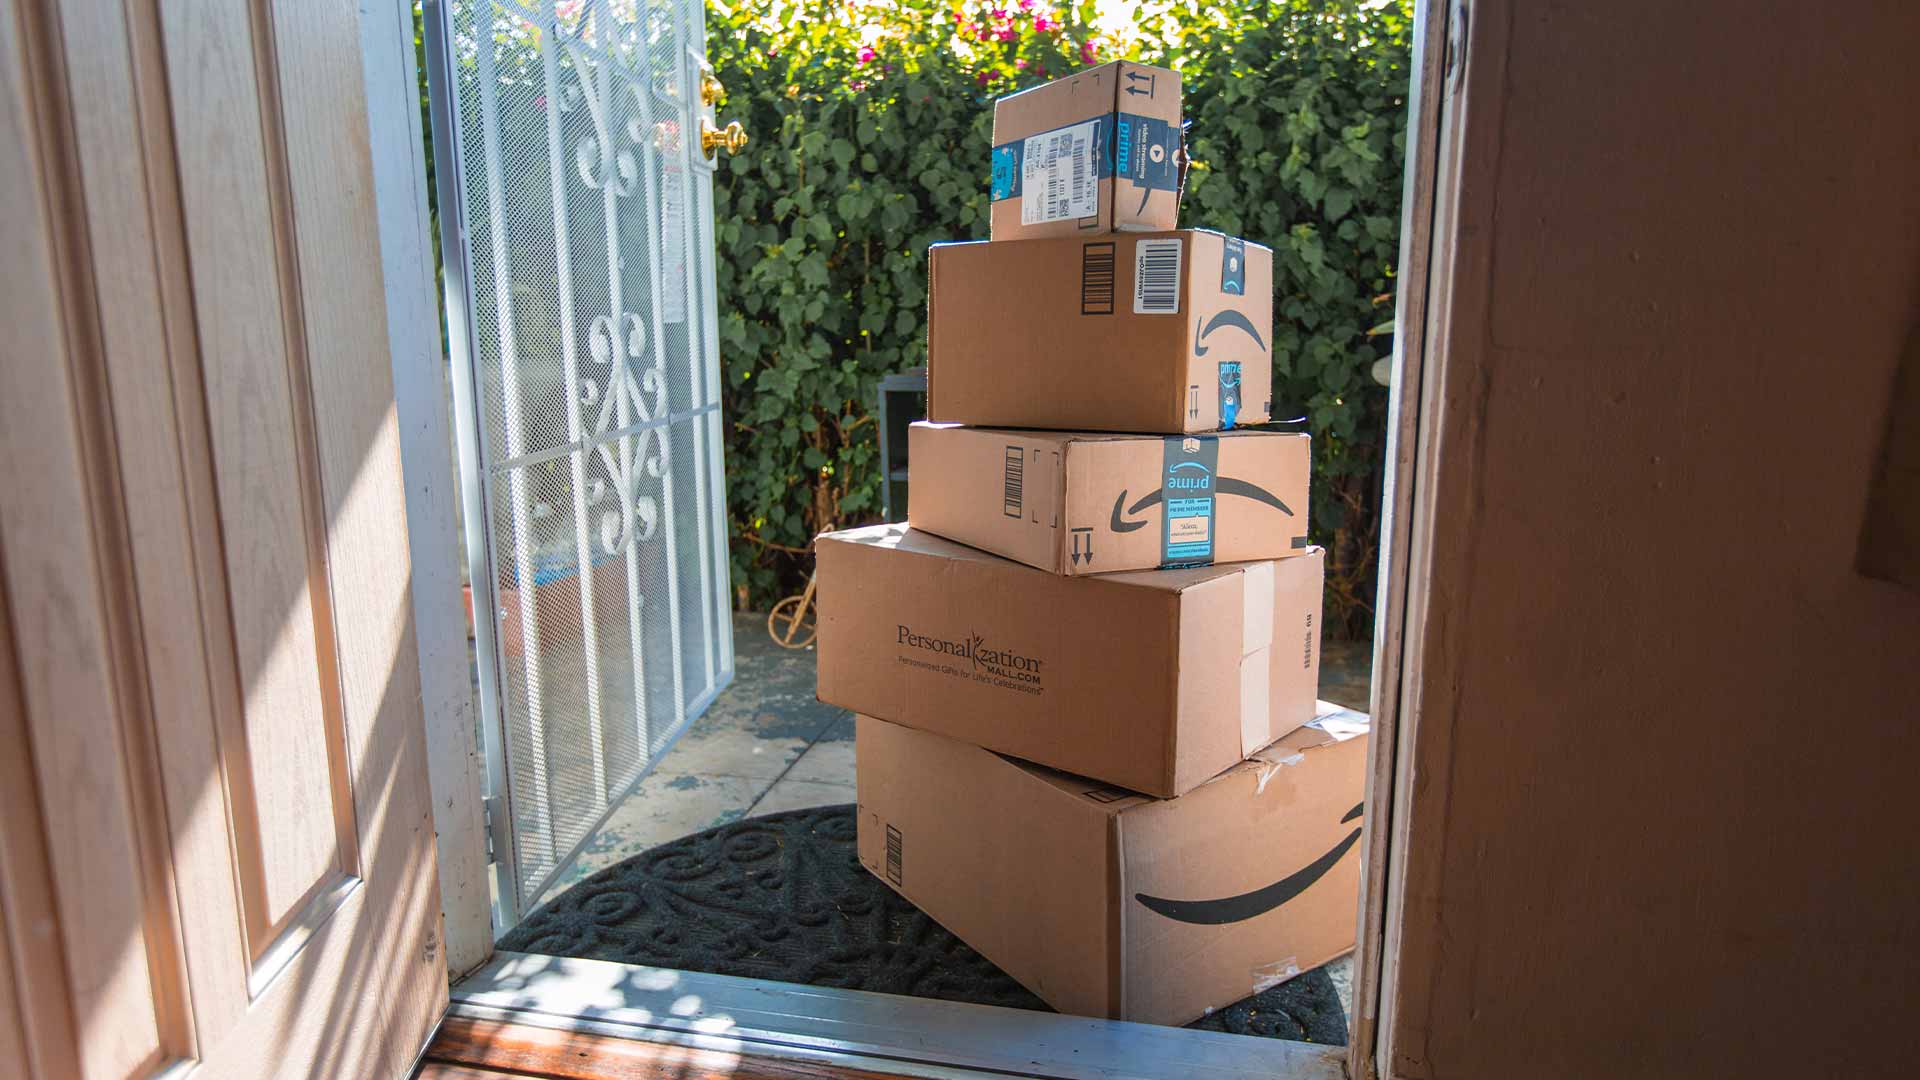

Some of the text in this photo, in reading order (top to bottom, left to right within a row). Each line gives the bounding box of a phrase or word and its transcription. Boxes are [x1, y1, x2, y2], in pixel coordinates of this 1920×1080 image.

[1119, 121, 1131, 172] prime
[1139, 143, 1147, 179] streaming
[1168, 475, 1209, 493] prime
[898, 656, 940, 673] Personalized
[942, 665, 959, 677] Gifts
[960, 669, 971, 679] for
[972, 672, 992, 684] Life's
[987, 665, 1041, 685] MALL.COM
